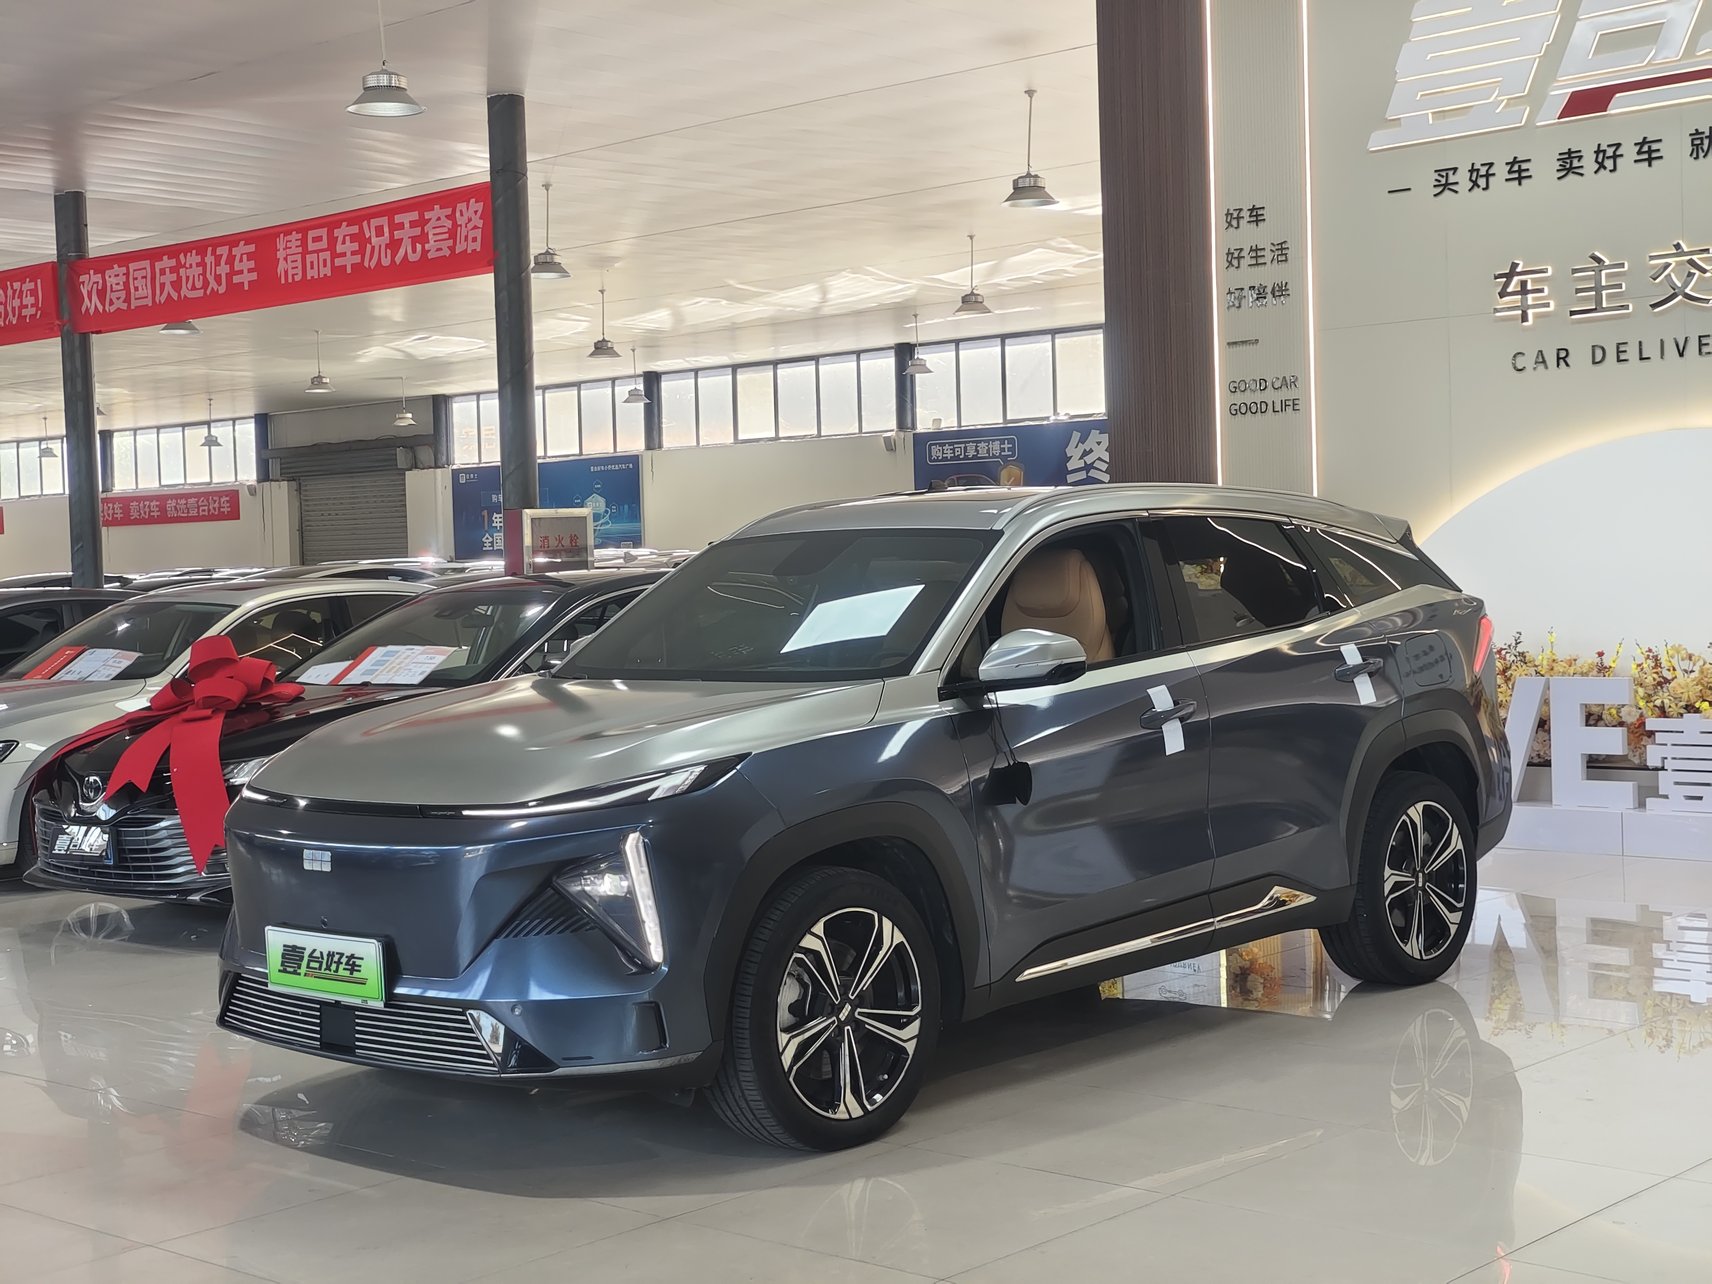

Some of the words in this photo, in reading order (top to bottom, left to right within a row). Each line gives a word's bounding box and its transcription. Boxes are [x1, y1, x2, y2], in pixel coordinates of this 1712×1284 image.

[1433, 156, 1533, 197] 买好车
[1556, 136, 1664, 180] 卖好车
[1225, 204, 1266, 230] 好车
[79, 241, 257, 316] 欢度国庆选好车
[276, 198, 485, 284] 精品车况无套路
[1225, 240, 1290, 270] 好生活
[1226, 281, 1291, 310] 好陪伴
[1494, 241, 1712, 325] 车主交
[1511, 347, 1571, 372] CAR
[1591, 334, 1712, 365] DELIVE
[1228, 378, 1268, 394] GOOD
[1271, 375, 1299, 391] CAR
[1228, 400, 1269, 417] GOOD
[1271, 398, 1300, 414] LIFE
[930, 439, 1013, 460] 购车可享查博士
[1065, 429, 1111, 484] 终
[101, 501, 124, 521] 好车
[539, 533, 580, 549] 消火栓
[277, 943, 365, 977] 壹台好车
